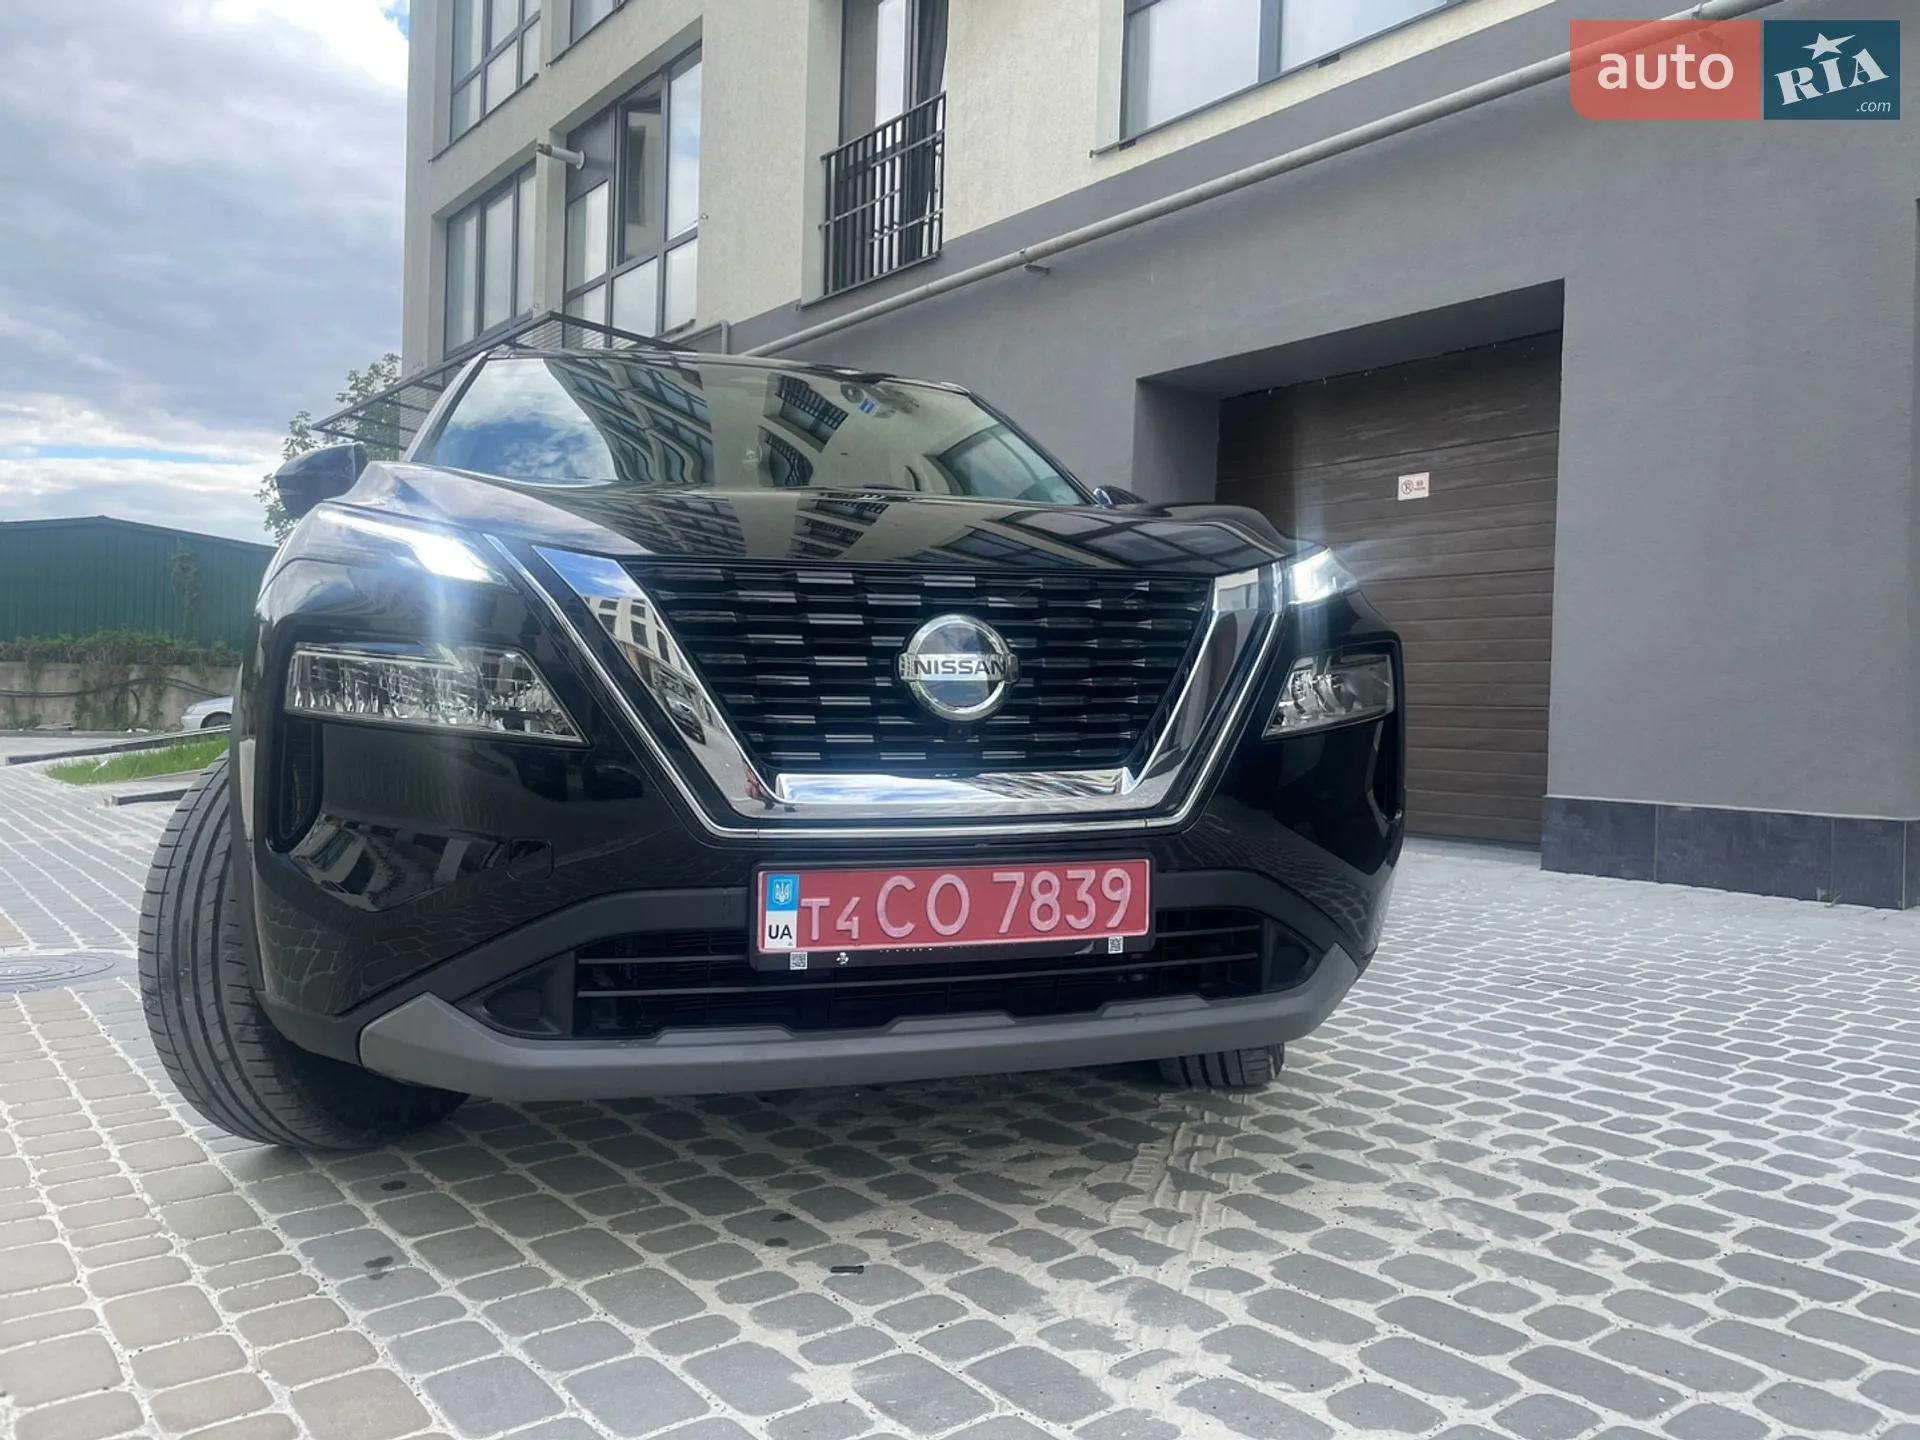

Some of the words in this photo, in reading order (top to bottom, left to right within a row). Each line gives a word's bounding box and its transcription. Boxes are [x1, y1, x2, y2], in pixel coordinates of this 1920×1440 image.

[914, 659, 1006, 675] NISSAN
[992, 867, 1132, 934] 7839
[768, 924, 792, 940] UA
